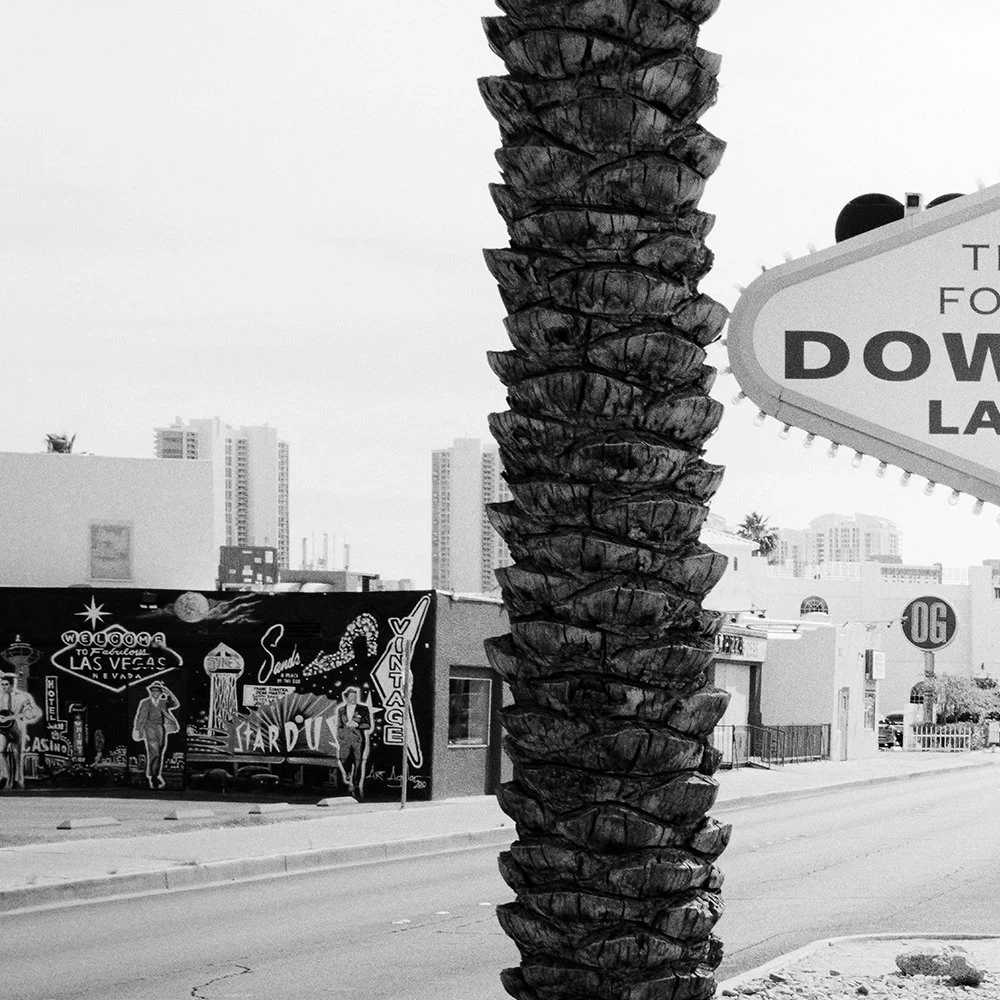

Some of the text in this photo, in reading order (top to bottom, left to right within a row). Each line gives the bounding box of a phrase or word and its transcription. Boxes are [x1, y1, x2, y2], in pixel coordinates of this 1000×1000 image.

[910, 601, 948, 644] OG
[63, 631, 164, 646] WELCOME
[75, 648, 89, 656] TO
[258, 624, 300, 683] Sands
[69, 656, 167, 671] LAS VEGAS
[92, 672, 142, 680] NEVADA
[386, 618, 411, 744] VINTAGE
[48, 679, 56, 721] HOTEL
[24, 734, 68, 754] CASINO
